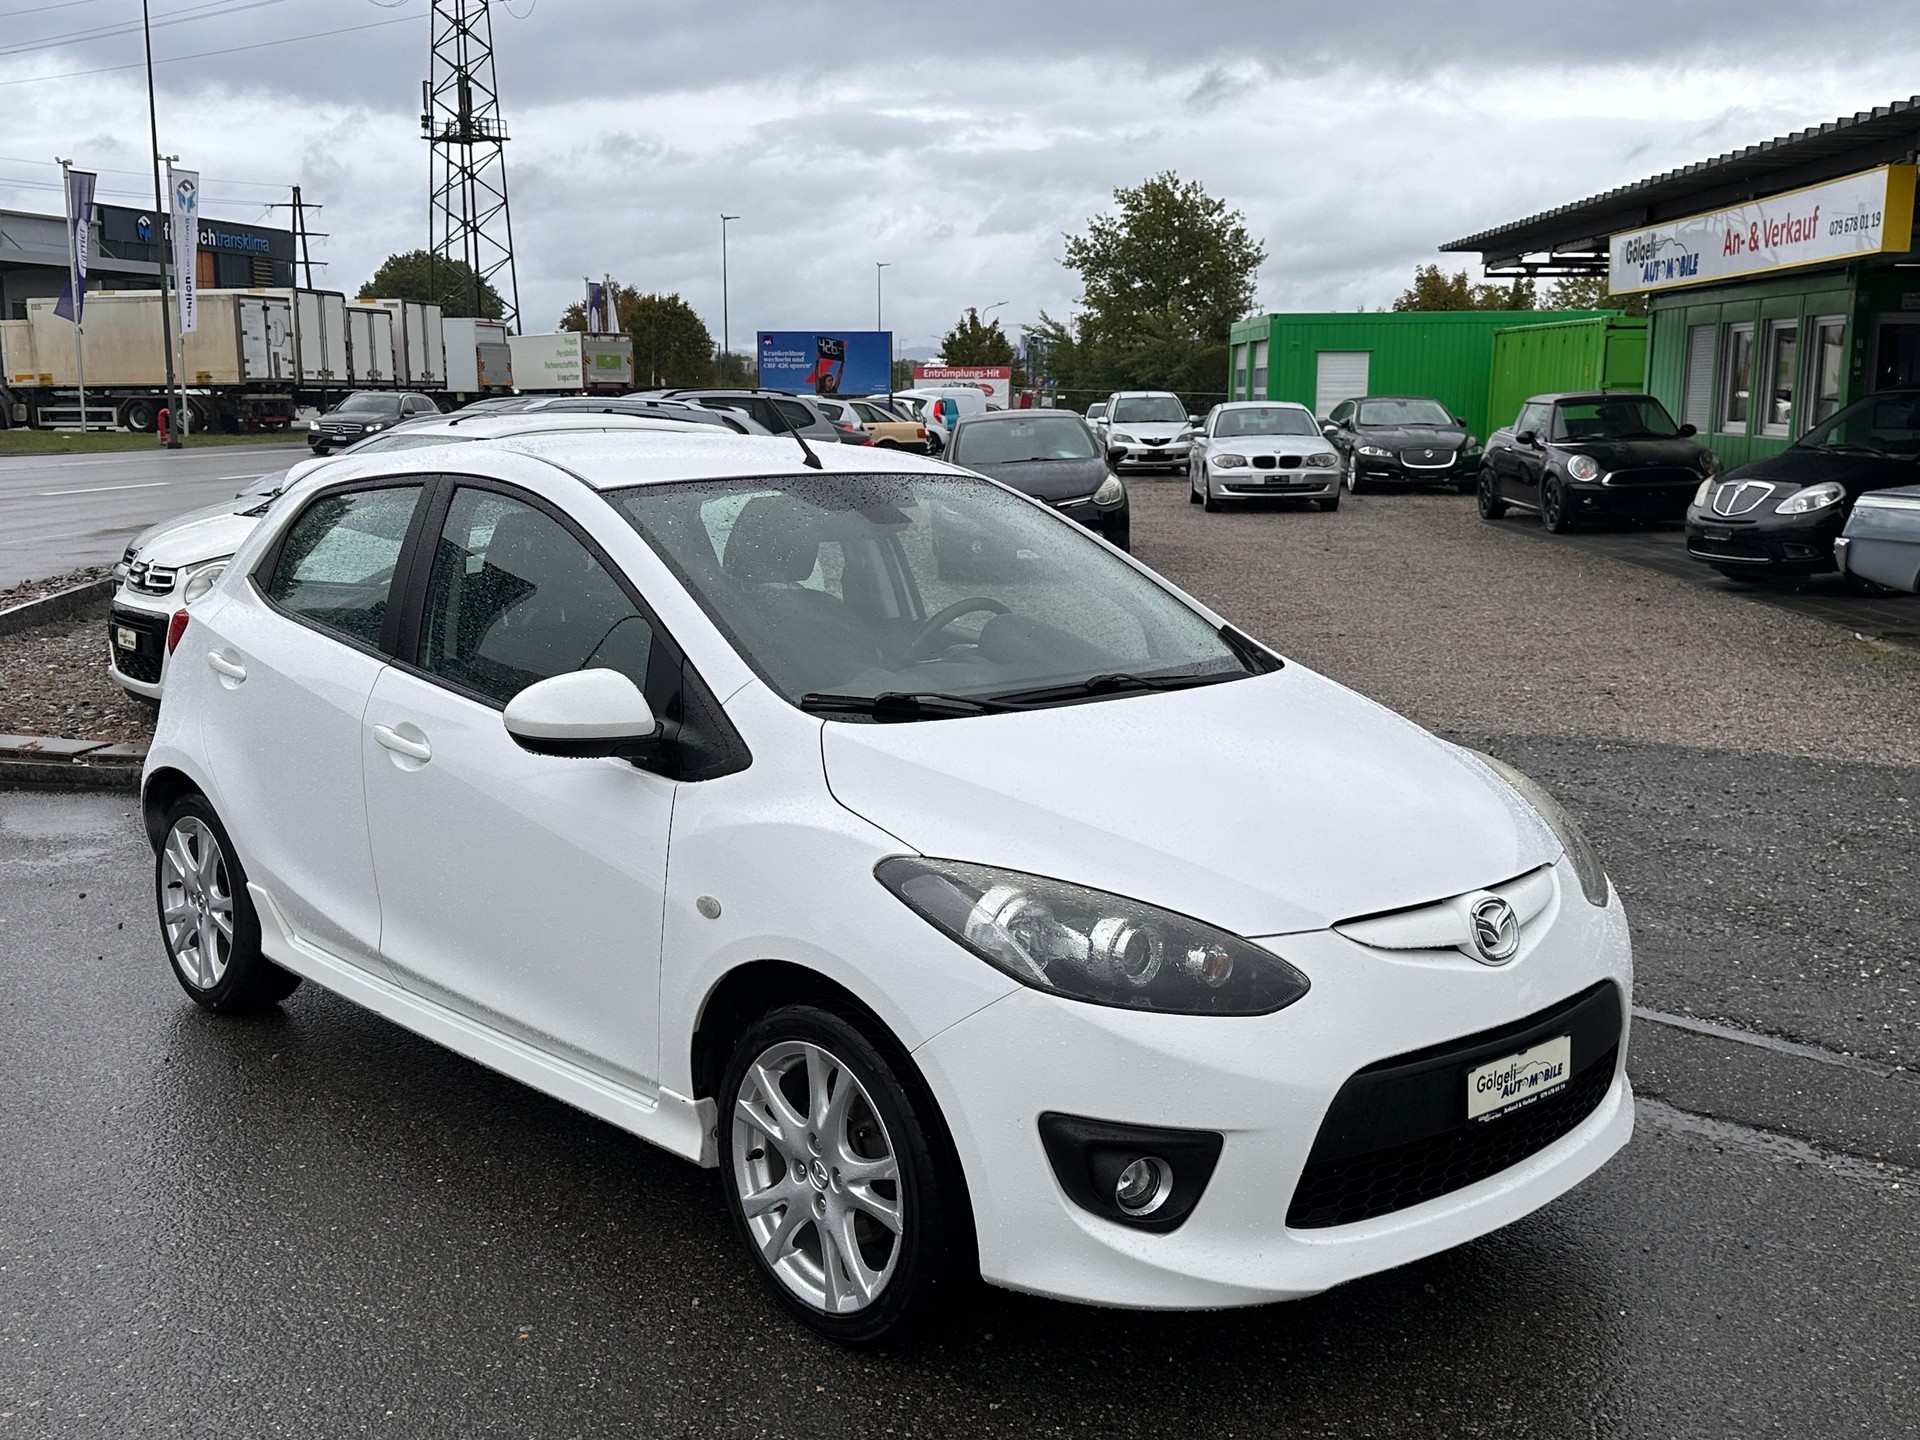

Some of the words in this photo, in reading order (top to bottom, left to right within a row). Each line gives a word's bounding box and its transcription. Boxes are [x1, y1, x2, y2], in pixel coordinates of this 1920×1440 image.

[1723, 229, 1746, 256] An-
[1749, 221, 1760, 252] &
[1763, 205, 1820, 248] Verkauf
[1829, 220, 1843, 236] 079
[1844, 216, 1858, 232] 678
[1859, 213, 1869, 230] 01
[1870, 211, 1881, 227] 19
[1625, 233, 1657, 268] Gölgeli
[923, 368, 1000, 379] Entrümplungs-Hit
[1476, 1062, 1517, 1094] Gölgeli
